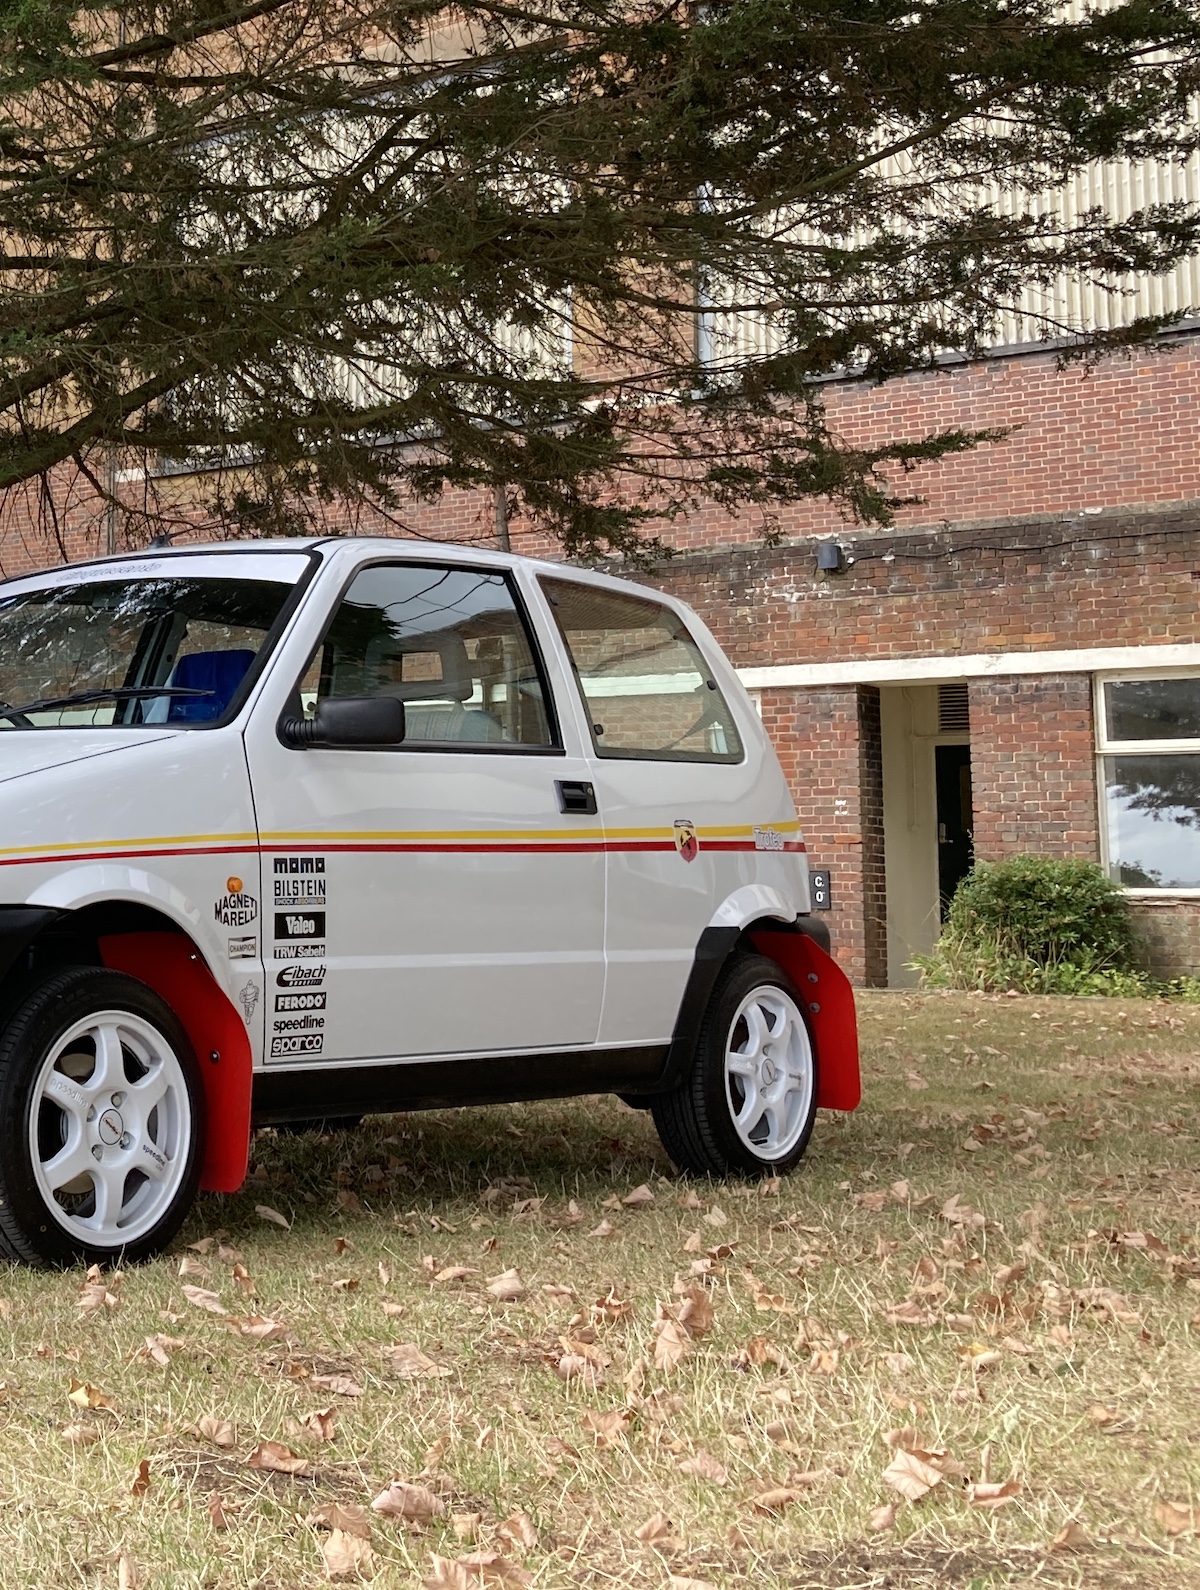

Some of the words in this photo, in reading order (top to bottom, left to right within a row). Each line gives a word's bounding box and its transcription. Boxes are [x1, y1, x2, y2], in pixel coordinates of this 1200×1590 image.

[753, 827, 784, 848] Trofeo
[274, 879, 326, 897] BILSTEIN
[214, 893, 258, 911] MAGNETI
[214, 908, 258, 927] MARELLI
[285, 916, 316, 935] Valeo
[229, 943, 256, 953] CHAMPION
[274, 946, 297, 959] TRW
[297, 945, 325, 958] Sabelt
[276, 964, 327, 986] Eibach
[277, 994, 324, 1011] FERODO
[272, 1014, 325, 1034] speedline
[272, 1035, 322, 1057] sparco
